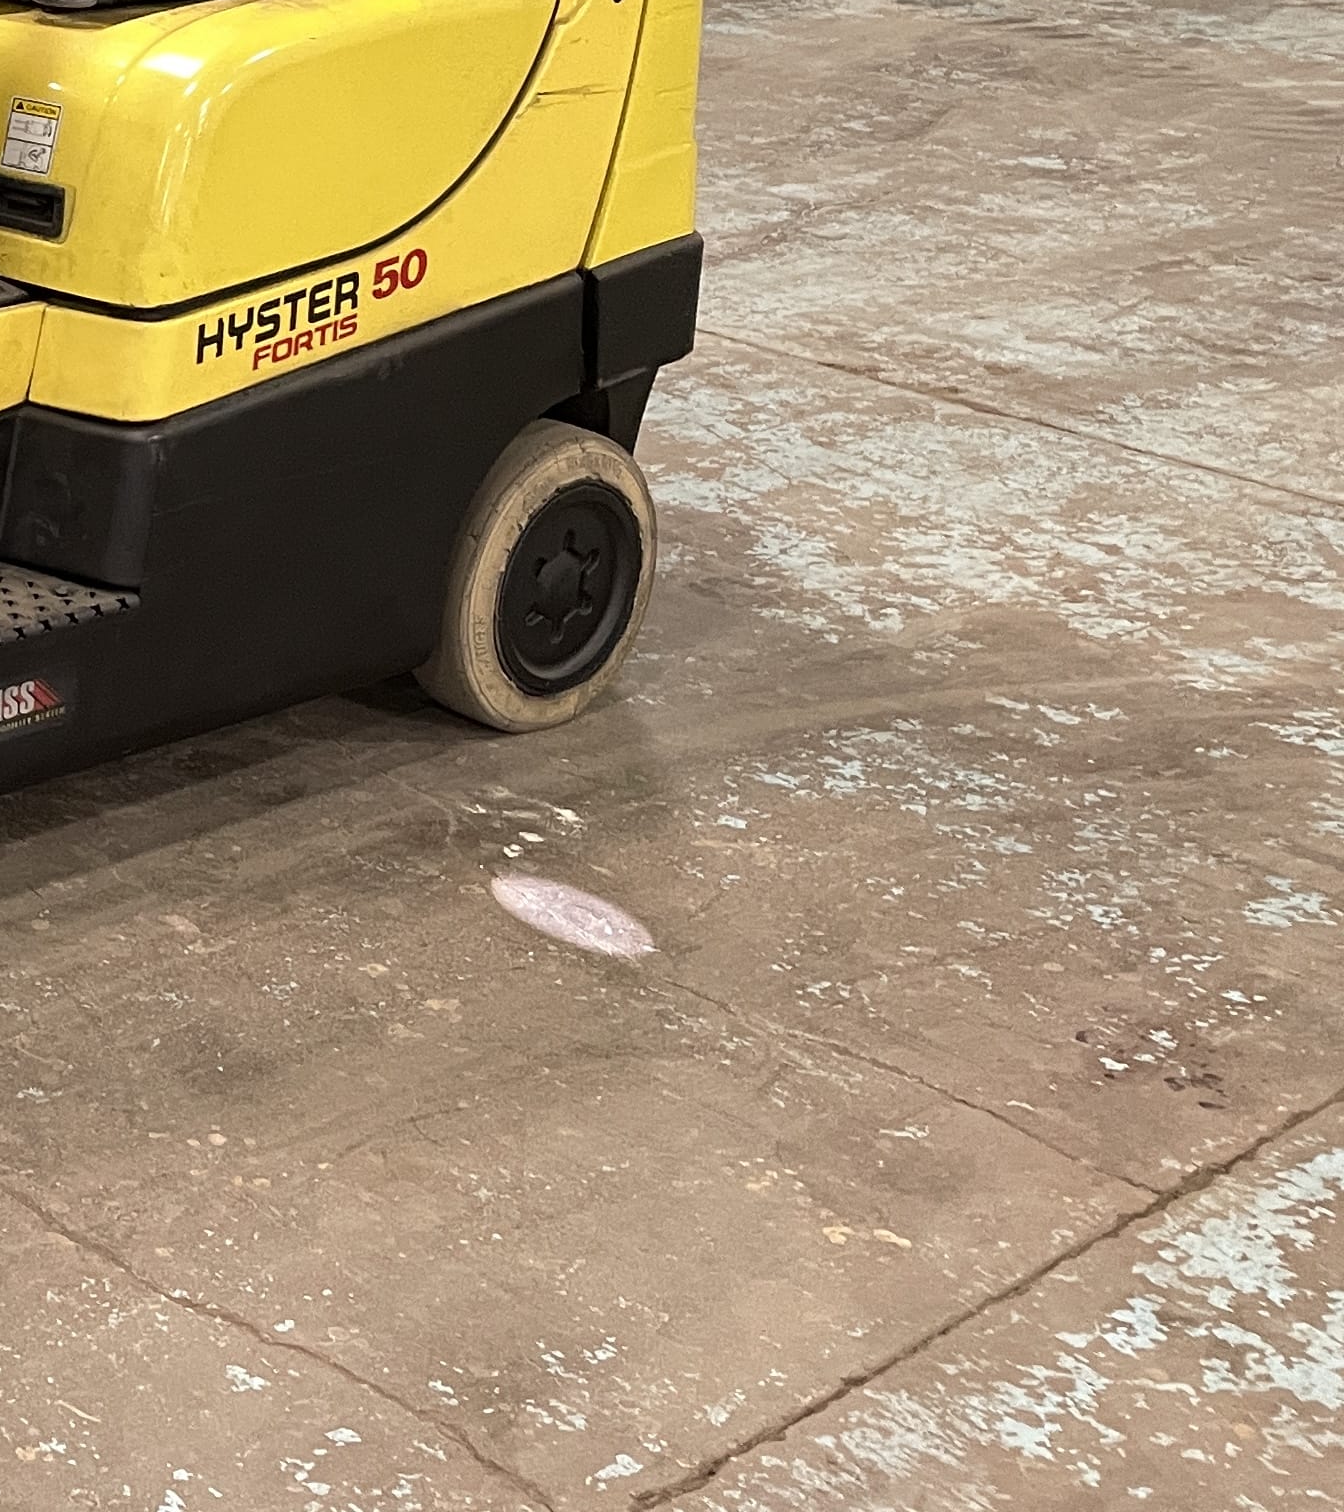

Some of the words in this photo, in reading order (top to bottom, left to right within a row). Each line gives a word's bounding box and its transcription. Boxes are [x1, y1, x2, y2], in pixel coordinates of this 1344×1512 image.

[25, 103, 57, 116] CAUTION
[196, 271, 360, 365] HYSTER
[371, 248, 428, 300] 50
[252, 313, 359, 371] FORTIS
